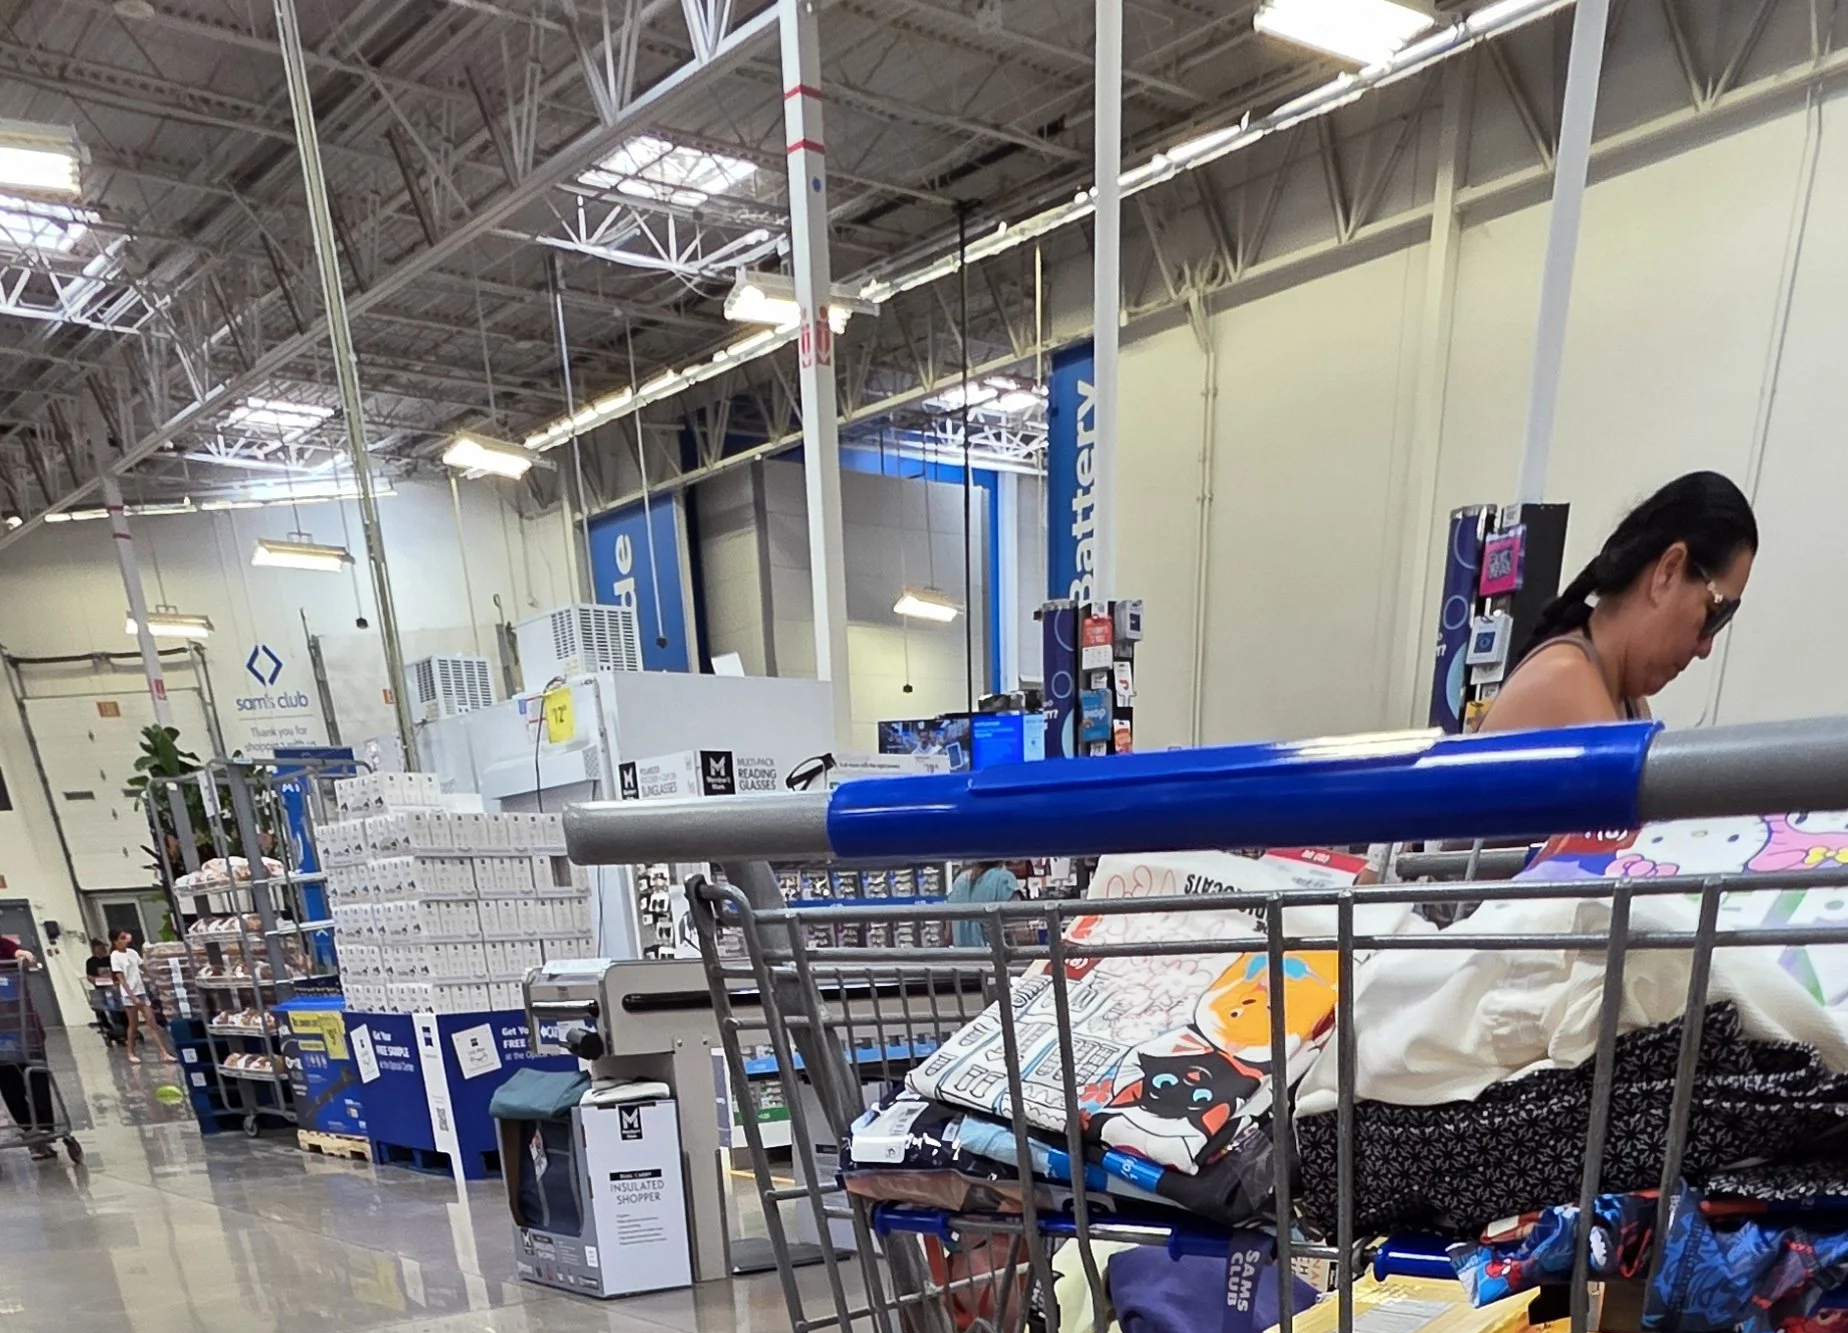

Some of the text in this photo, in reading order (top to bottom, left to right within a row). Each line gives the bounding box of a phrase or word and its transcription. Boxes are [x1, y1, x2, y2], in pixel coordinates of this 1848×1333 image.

[1069, 379, 1097, 606] Battery
[236, 691, 309, 711] sam's club
[251, 726, 277, 738] Thank
[278, 729, 295, 740] you
[736, 757, 775, 767] MULTI-PACK
[738, 768, 777, 780] READING
[738, 779, 776, 791] GLASSES
[502, 1026, 529, 1036] Get Yo
[503, 1039, 526, 1048] FREE
[610, 1179, 664, 1192] INSULATED
[617, 1192, 661, 1205] SHOPPER
[1227, 1252, 1243, 1306] CLUB
[1238, 1250, 1260, 1312] SAMS
